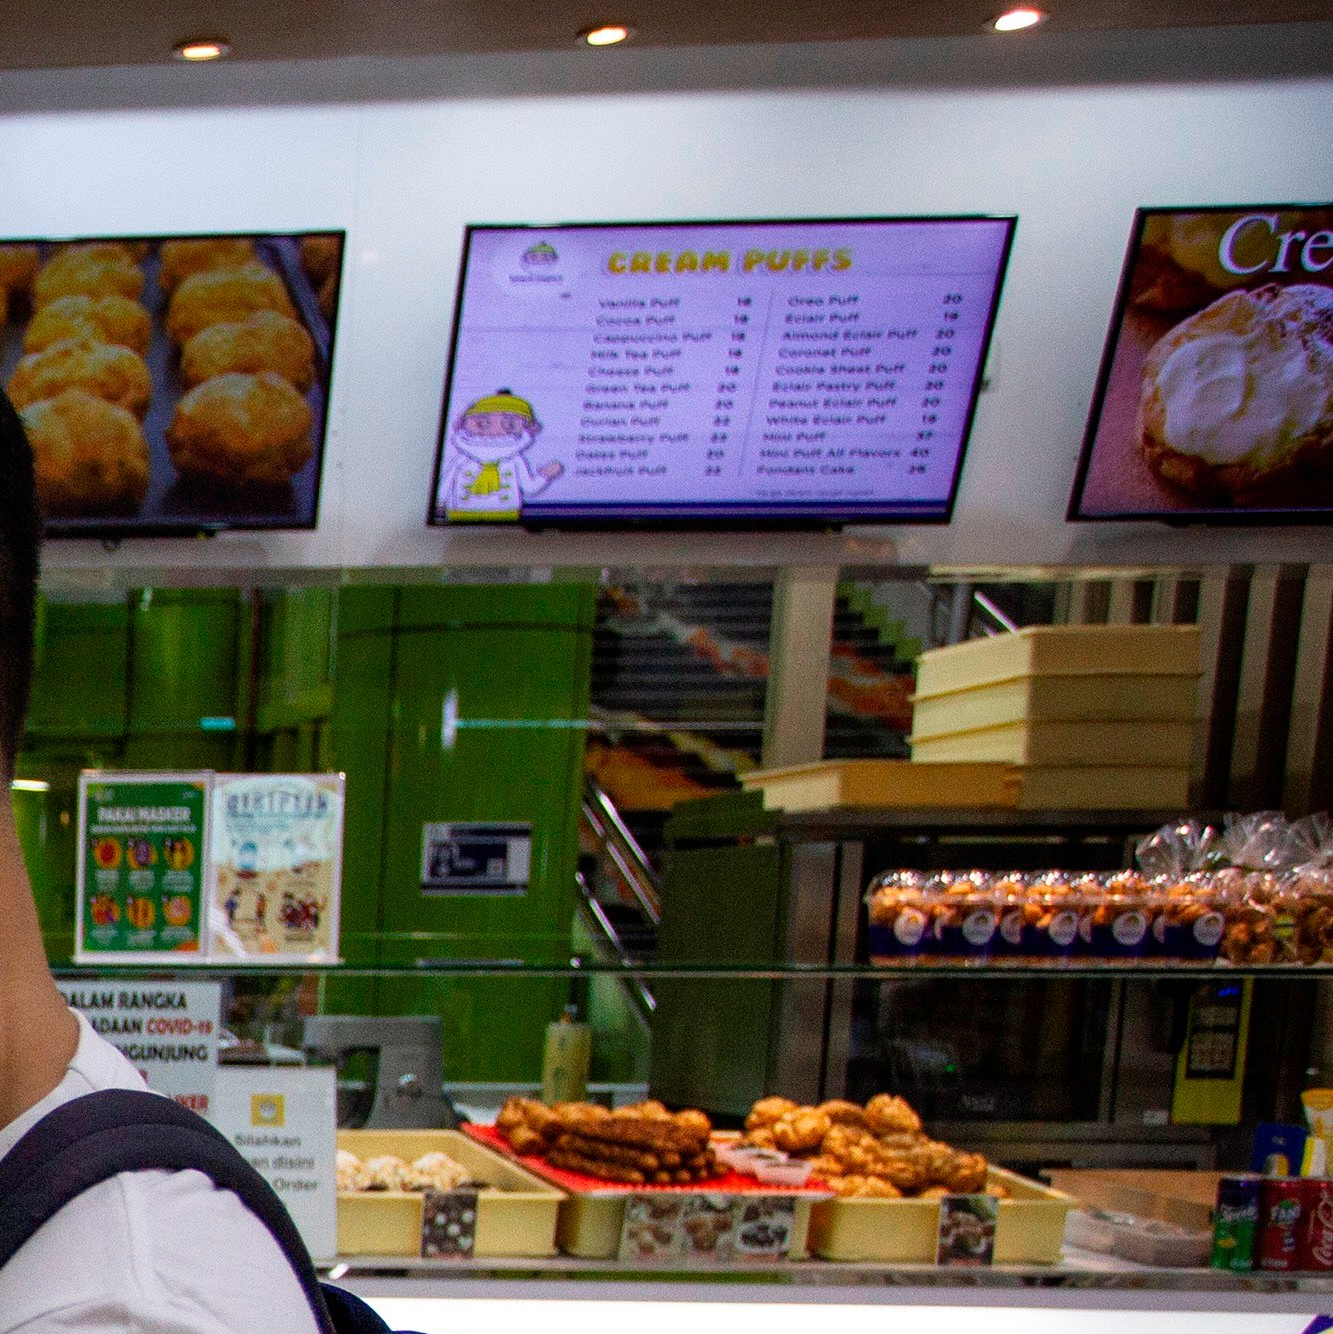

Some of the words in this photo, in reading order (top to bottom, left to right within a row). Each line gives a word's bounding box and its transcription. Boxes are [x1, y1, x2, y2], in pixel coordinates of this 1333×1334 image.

[606, 248, 730, 276] CREAM
[741, 246, 853, 273] PUFFS
[649, 298, 680, 307] Puff
[737, 297, 752, 307] 18
[828, 295, 859, 305] Puff
[645, 316, 675, 325] Puff
[734, 315, 749, 324] 18
[829, 313, 860, 323] Puff
[943, 312, 959, 321] 18
[887, 329, 918, 339] Puff
[639, 400, 669, 409] Puff
[856, 415, 886, 424] Puff
[922, 414, 937, 424] 18
[117, 991, 188, 1009] RANGKA
[146, 1017, 213, 1035] COVID-19
[124, 1044, 208, 1062] GUNJUNG
